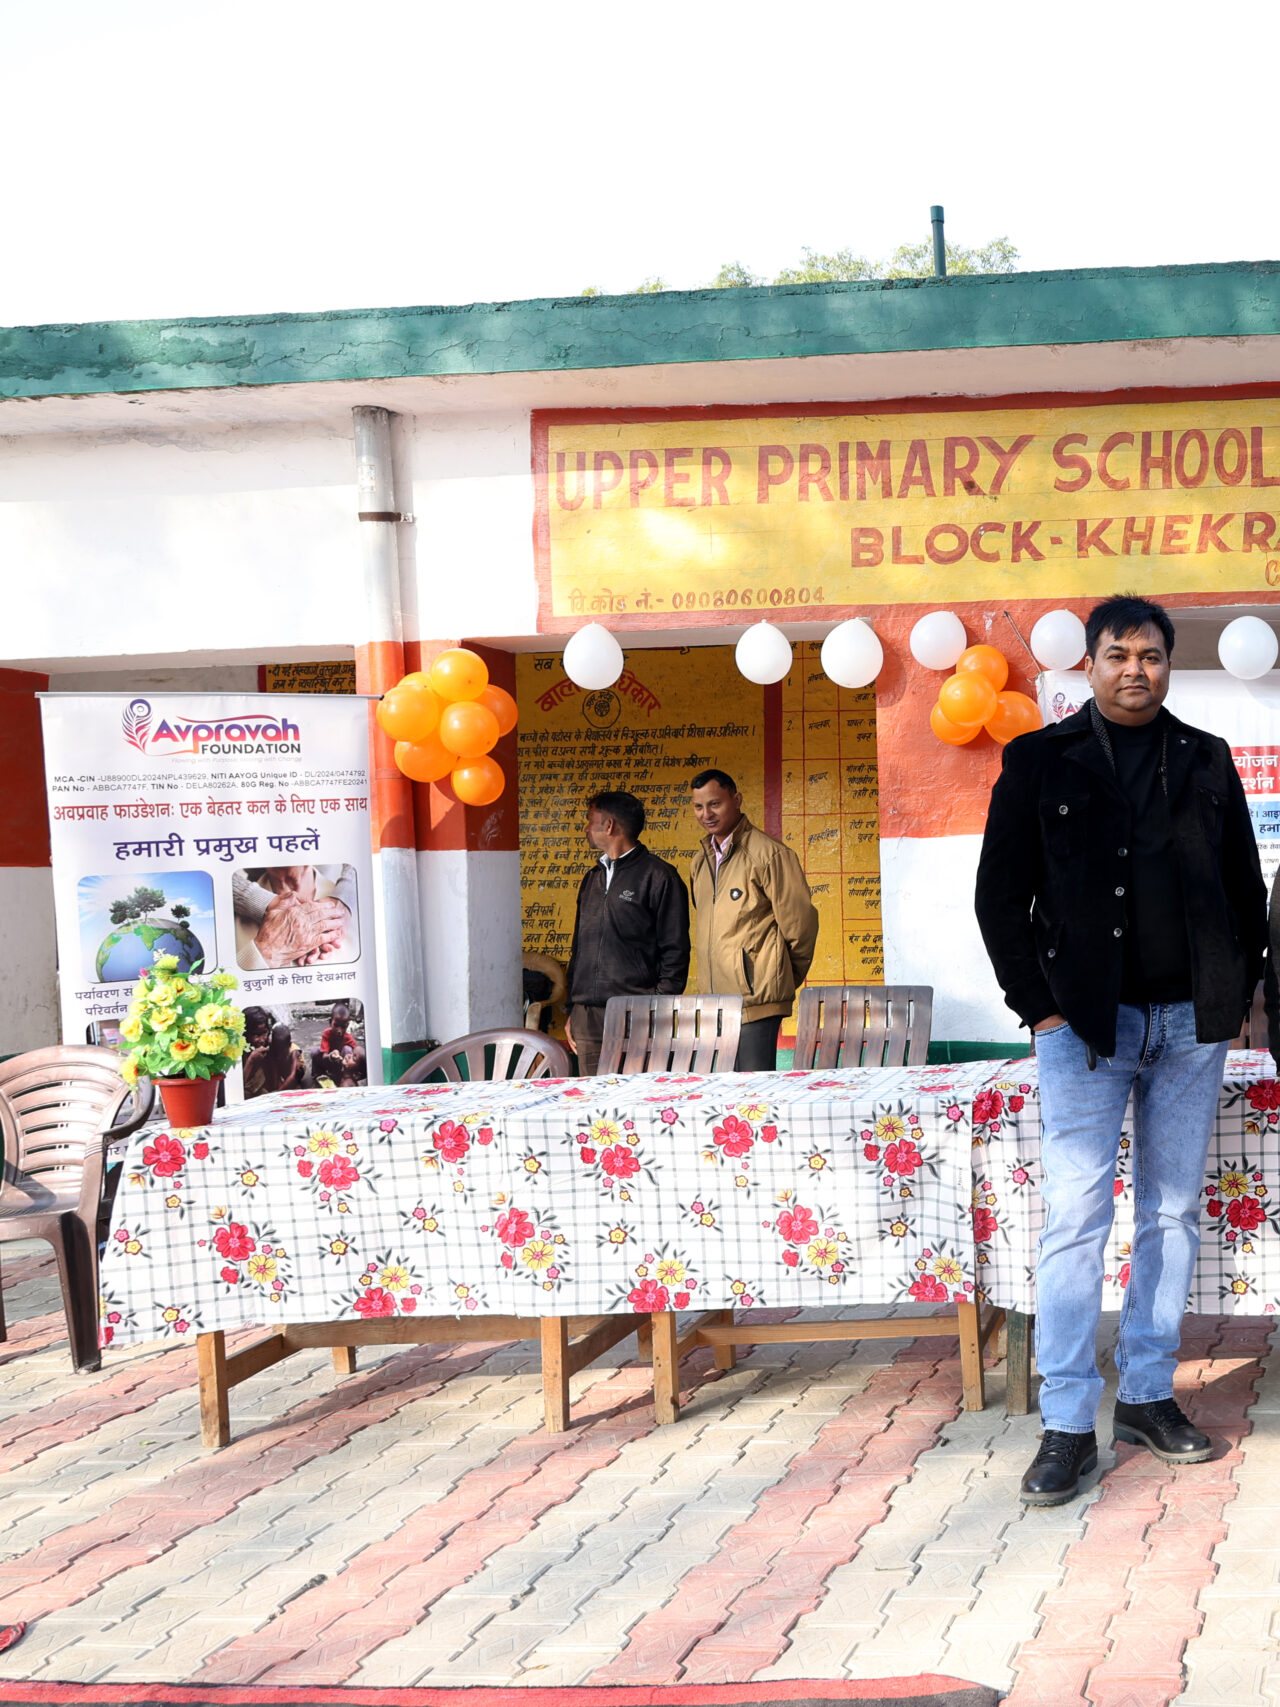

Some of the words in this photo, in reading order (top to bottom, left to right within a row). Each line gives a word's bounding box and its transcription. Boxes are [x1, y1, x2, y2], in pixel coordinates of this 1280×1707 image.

[557, 446, 731, 511] UPPER
[758, 434, 1034, 504] PRIMARY
[535, 658, 554, 671] सब
[613, 669, 661, 717] धिकार
[152, 718, 300, 754] Avpravah
[202, 743, 301, 755] FOUNDATION
[1232, 751, 1278, 768] योजन
[54, 804, 108, 821] अवप्रवाह
[179, 802, 202, 818] एक
[206, 796, 242, 816] बेहतर
[247, 800, 270, 814] कल
[275, 794, 287, 814] के
[290, 793, 315, 814] लिए
[320, 798, 340, 814] एक
[345, 797, 368, 812] साथ
[113, 833, 185, 861] हमारी
[194, 836, 258, 862] प्रमुख
[267, 827, 320, 853] पहलें
[278, 975, 289, 986] के
[292, 974, 313, 985] लिए
[316, 971, 356, 984] देखभाल
[75, 987, 120, 1001] पर्यावरण
[85, 1003, 128, 1016] परिवर्तन
